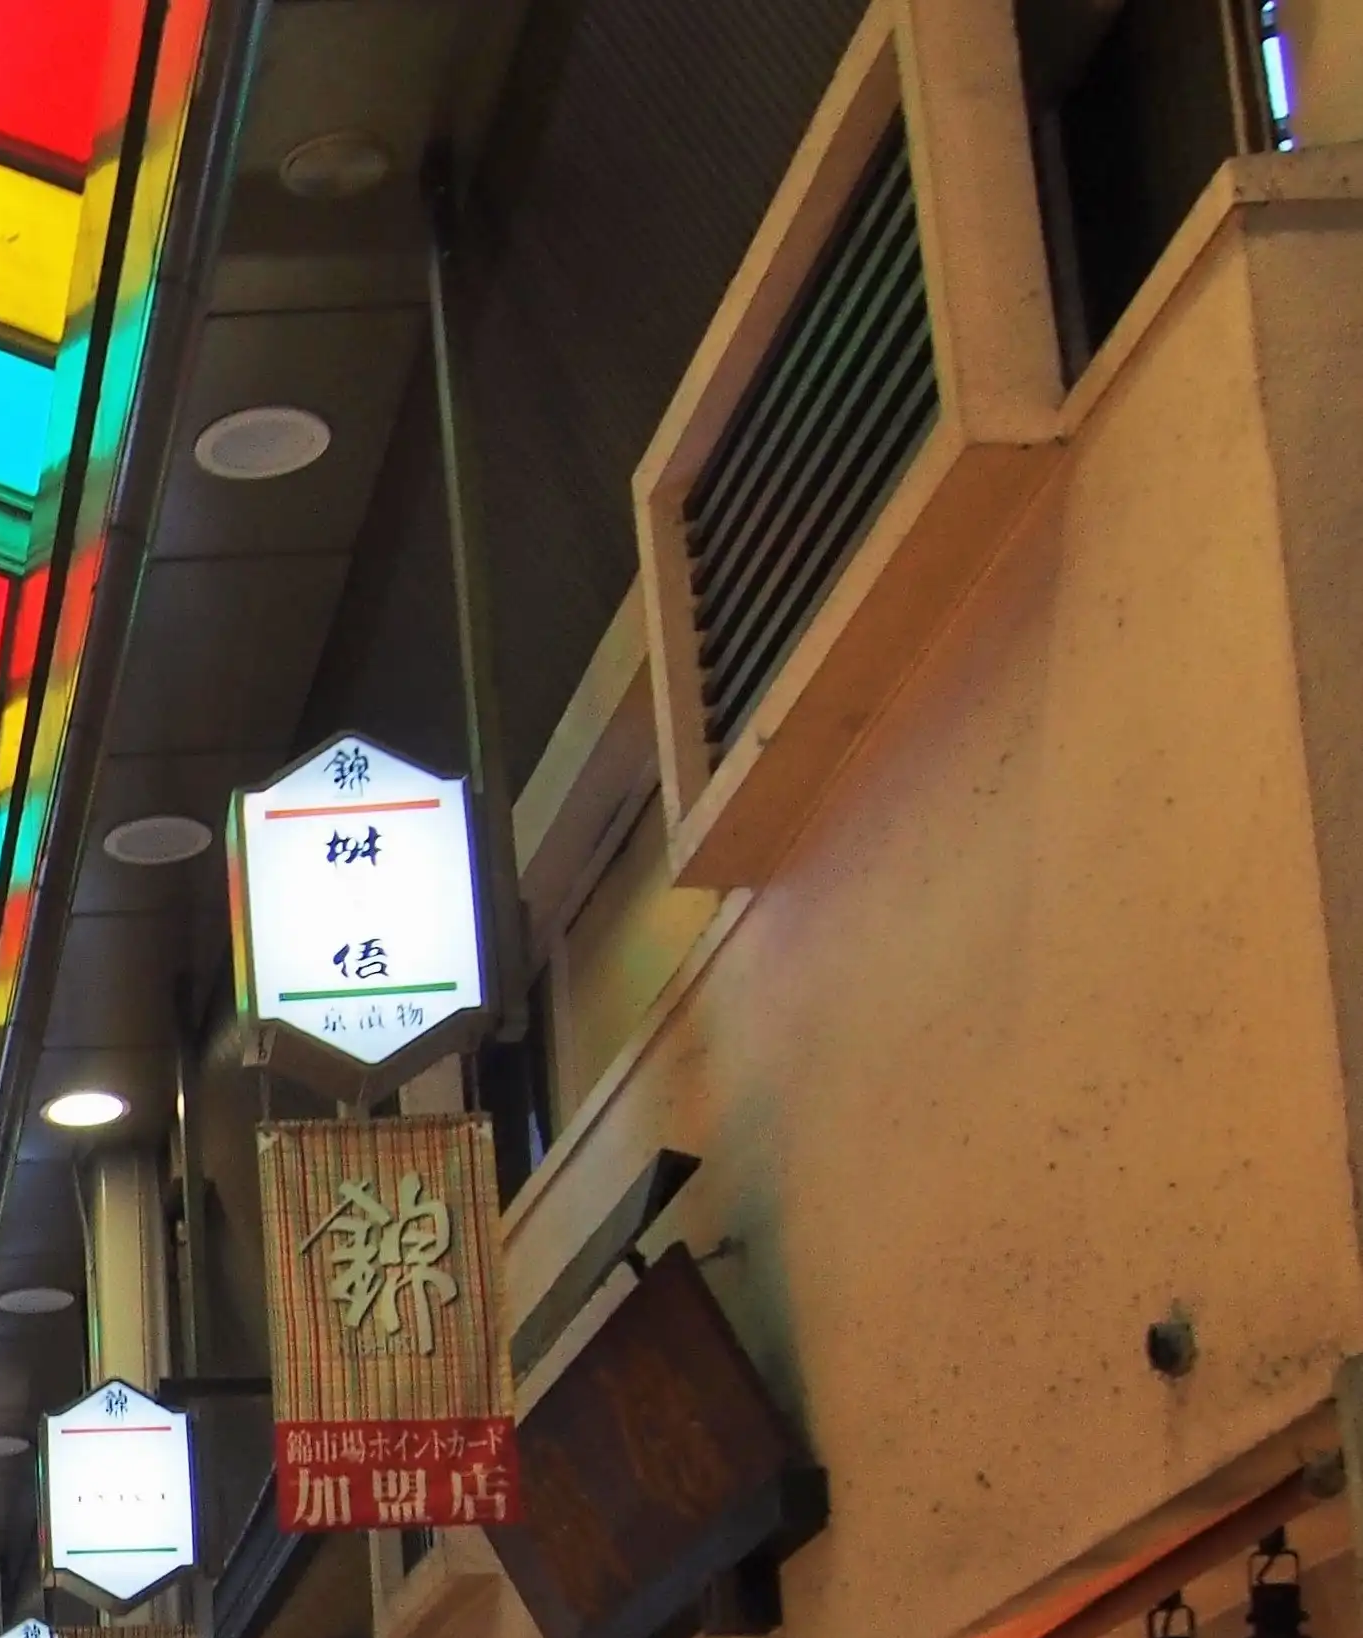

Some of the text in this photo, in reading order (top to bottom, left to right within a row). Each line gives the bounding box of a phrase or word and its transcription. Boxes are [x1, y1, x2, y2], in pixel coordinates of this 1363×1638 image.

[324, 747, 370, 796] 錦
[300, 1171, 459, 1357] 錦
[286, 1424, 505, 1468] 錦市場ポイントカード
[293, 1463, 512, 1527] 加盟店
